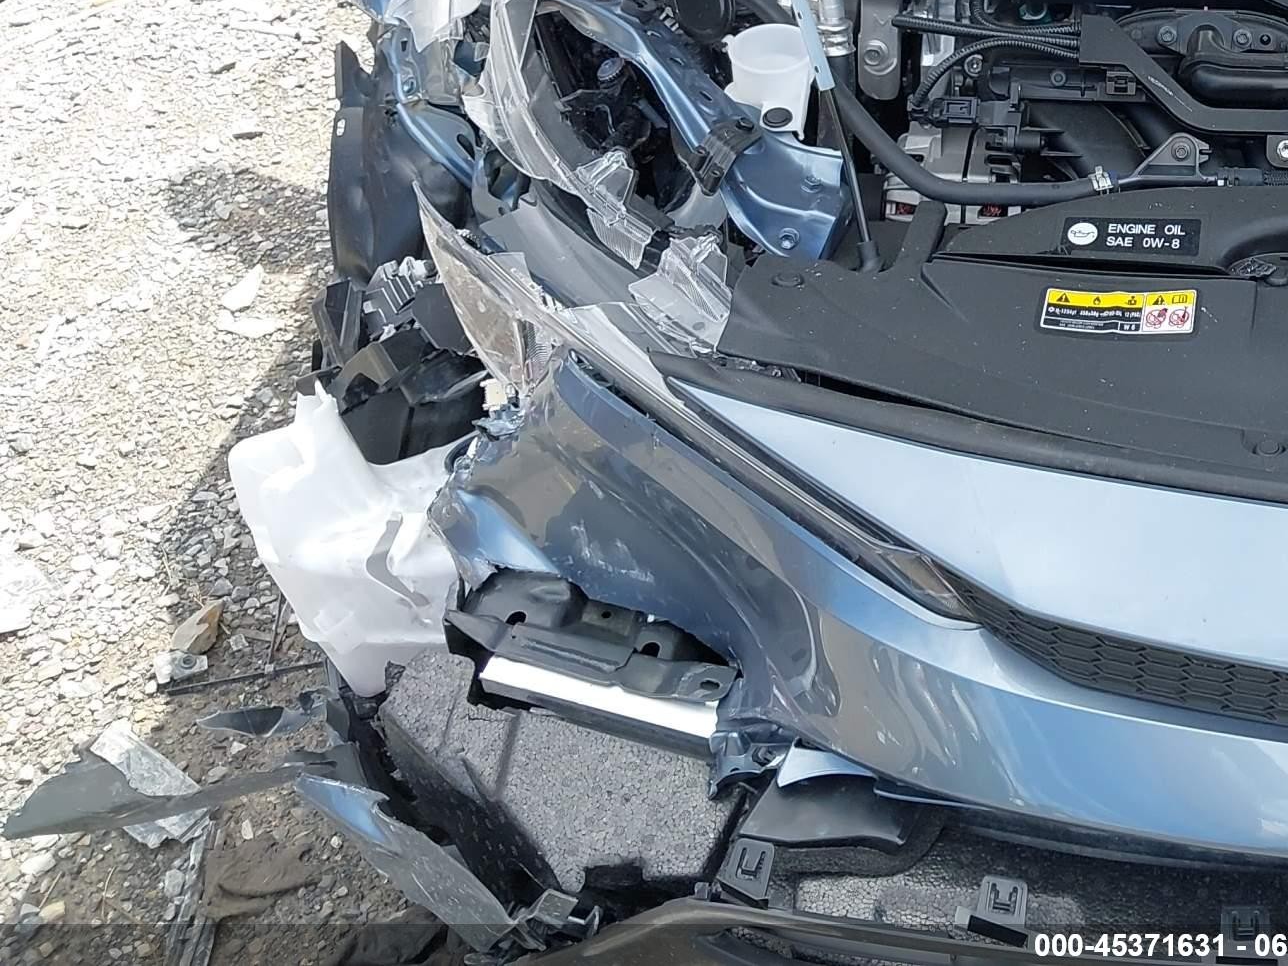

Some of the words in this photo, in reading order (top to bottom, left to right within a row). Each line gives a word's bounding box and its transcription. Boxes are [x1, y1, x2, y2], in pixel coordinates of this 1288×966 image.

[1107, 223, 1156, 234] ENGINE
[1164, 224, 1186, 235] OIL
[1106, 236, 1133, 247] SAE
[1143, 237, 1181, 249] 0W-8
